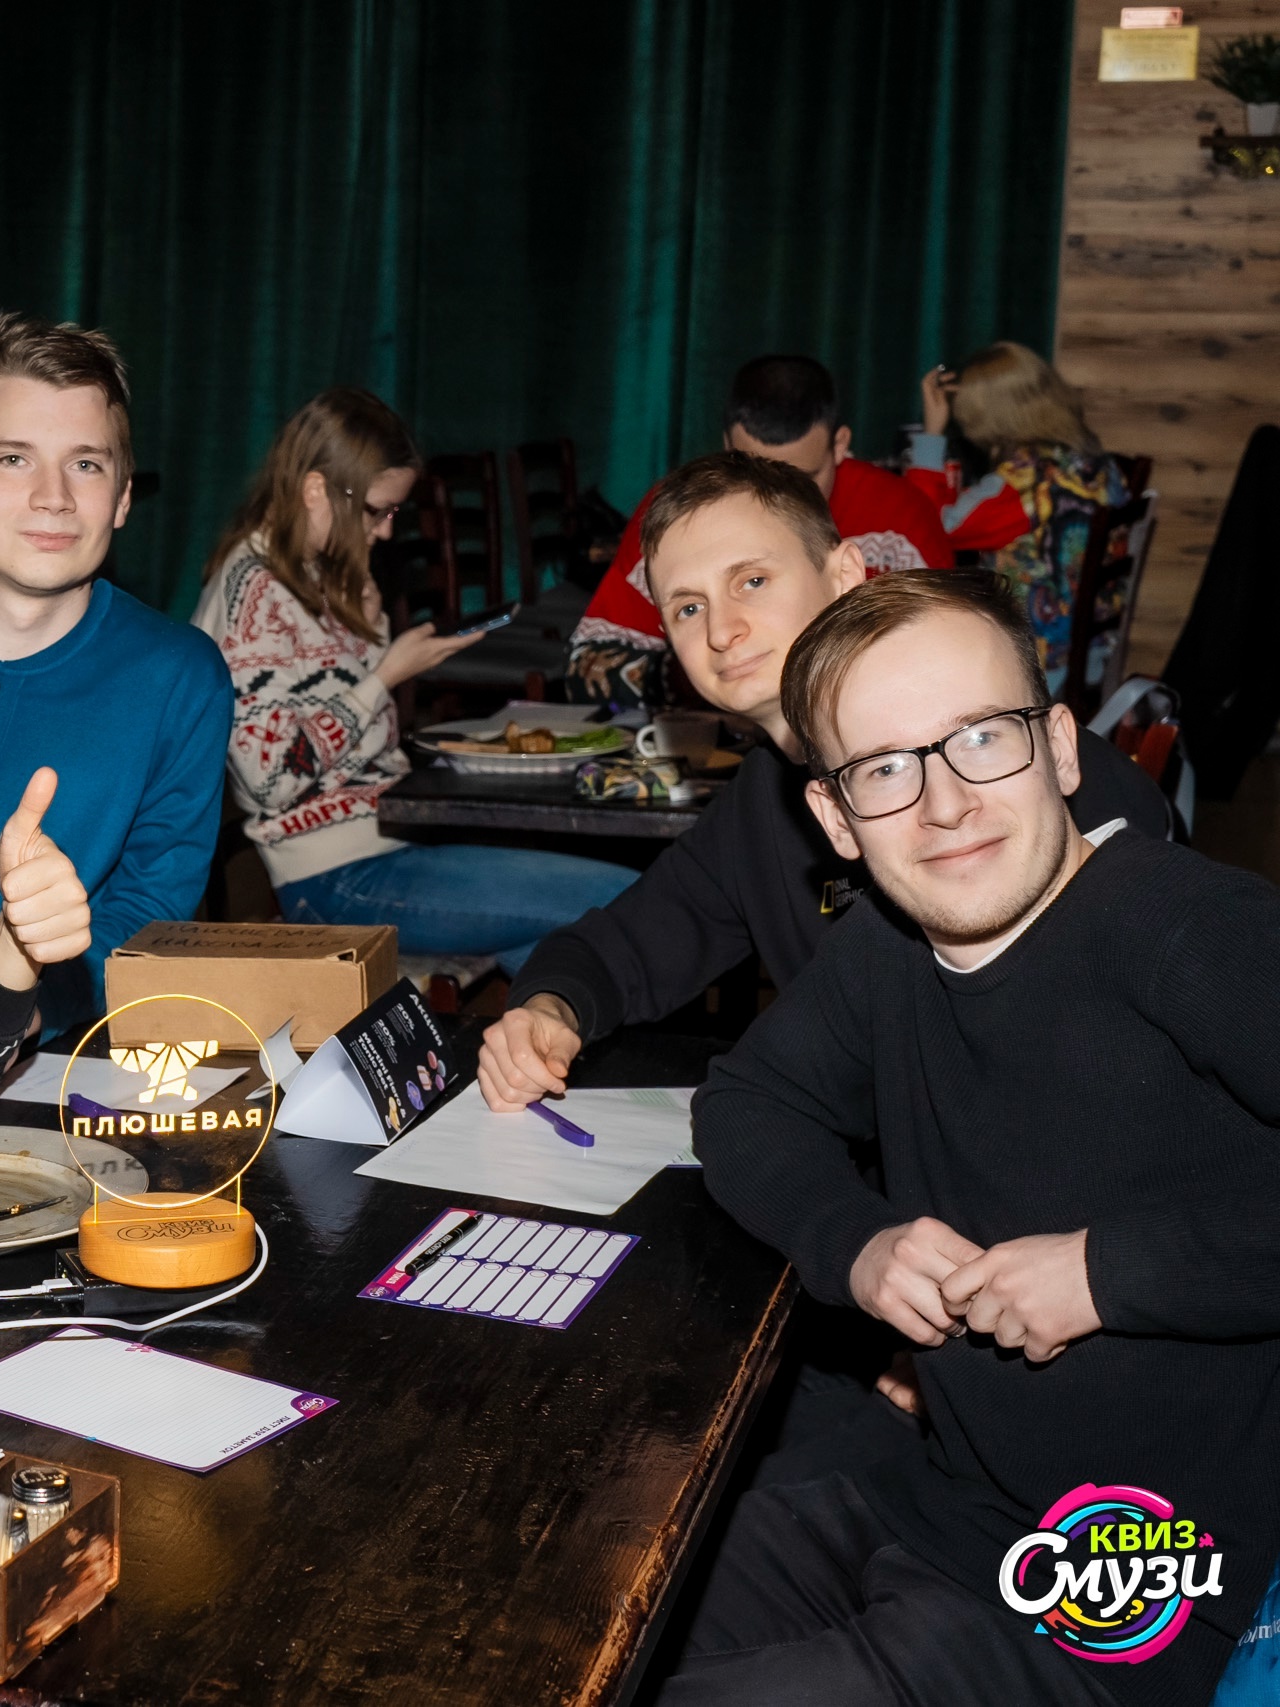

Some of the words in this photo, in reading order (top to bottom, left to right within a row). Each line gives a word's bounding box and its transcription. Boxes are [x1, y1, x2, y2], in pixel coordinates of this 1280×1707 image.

[396, 1003, 415, 1030] 20%
[377, 1019, 396, 1046] 20%
[358, 1035, 377, 1068] Tonic
[376, 1068, 388, 1090] Set
[362, 1032, 388, 1074] Martini
[72, 1107, 263, 1138] ПЛЮШЕВАЯ
[117, 1222, 235, 1241] Смузи
